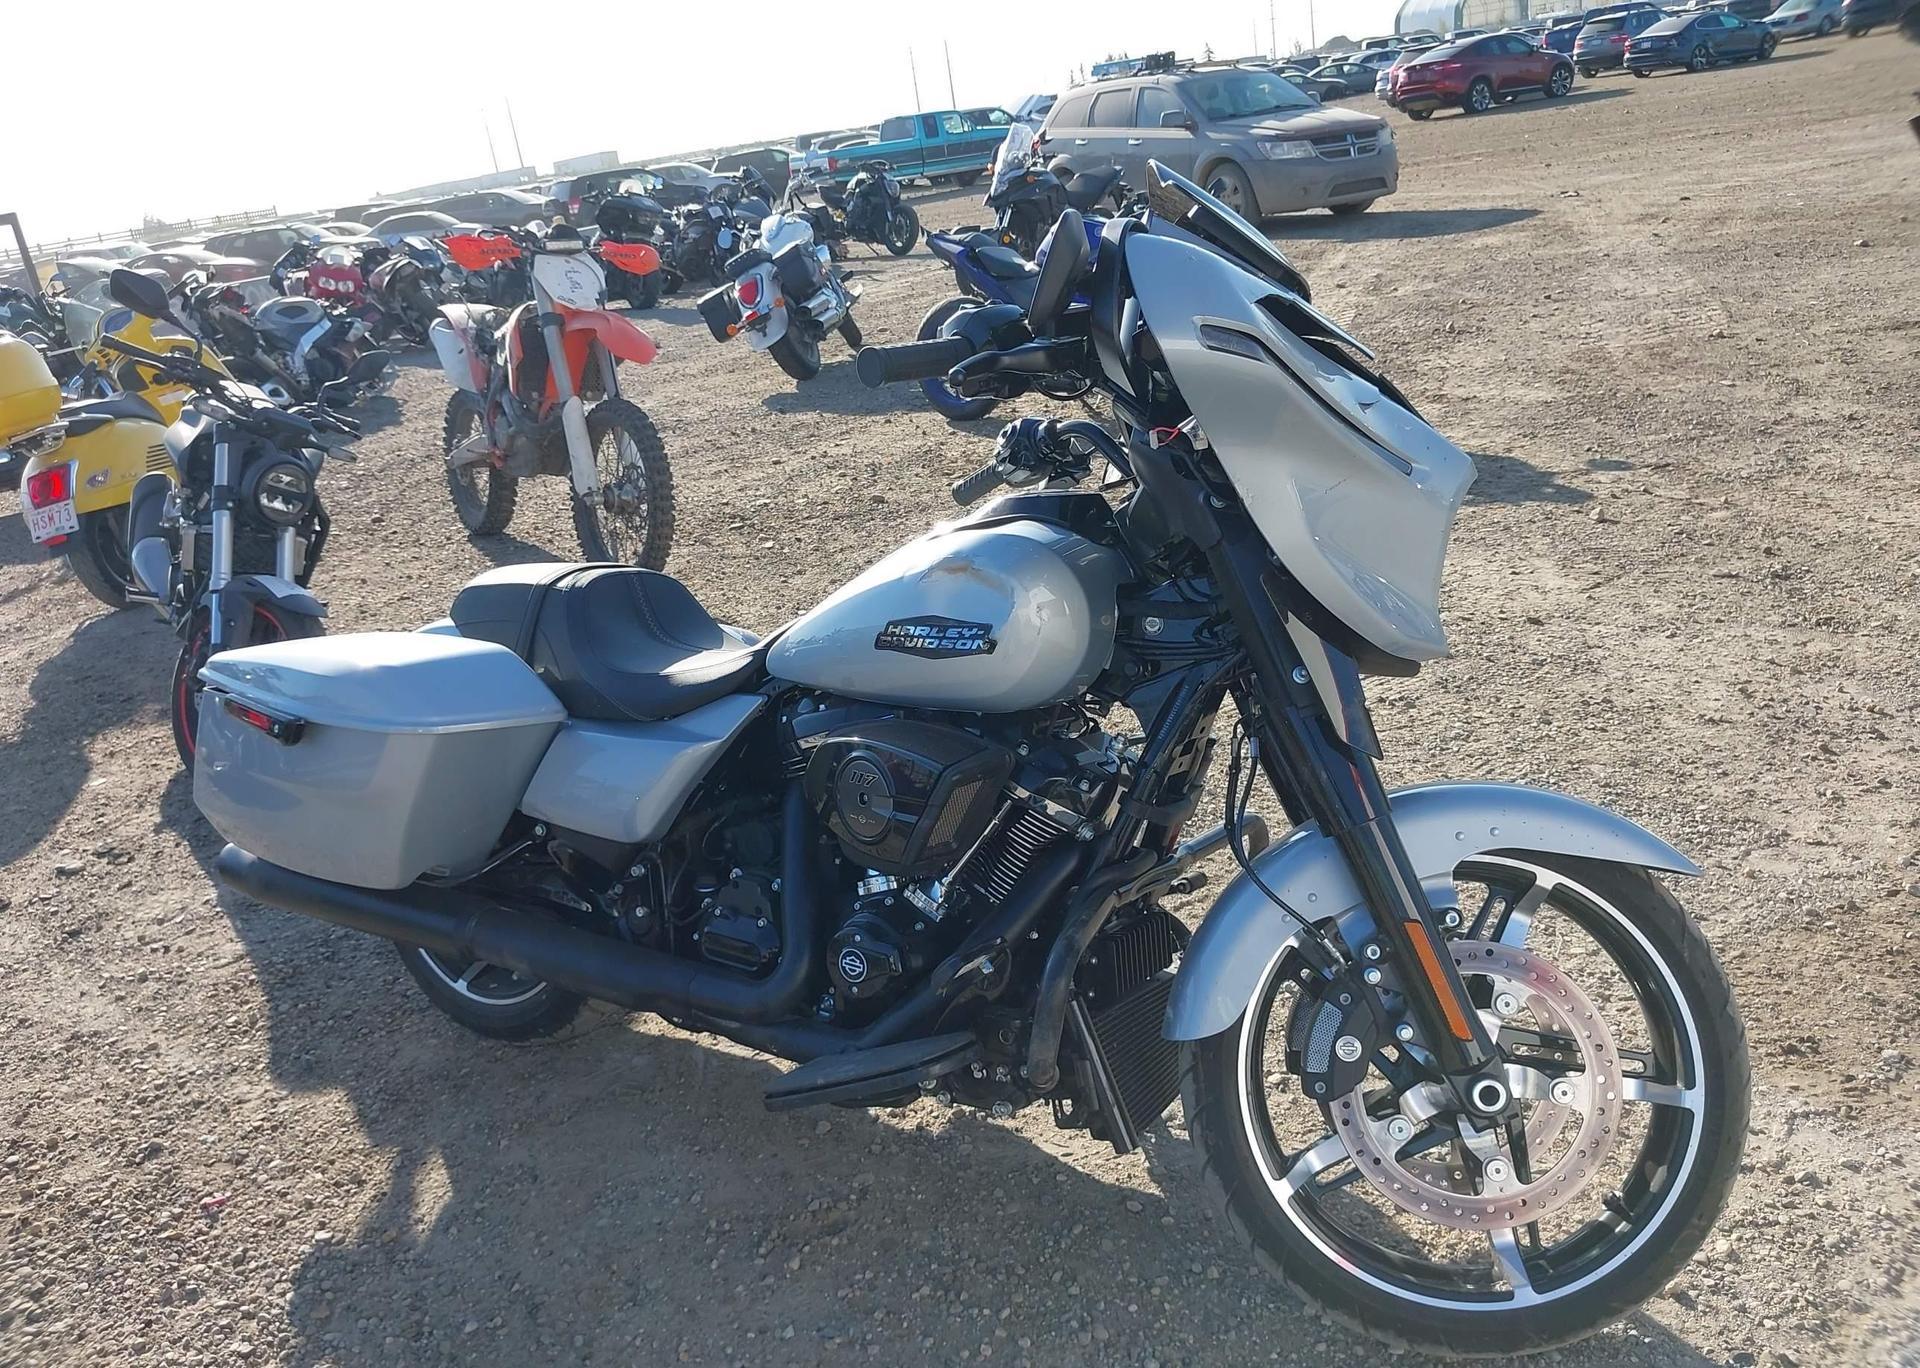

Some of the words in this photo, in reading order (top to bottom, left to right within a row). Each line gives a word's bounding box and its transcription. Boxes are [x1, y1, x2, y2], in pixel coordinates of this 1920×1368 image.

[32, 508, 72, 533] HSM73
[886, 625, 985, 638] HARLEY-
[879, 636, 990, 650] DAVIDSON
[849, 770, 879, 787] 117
